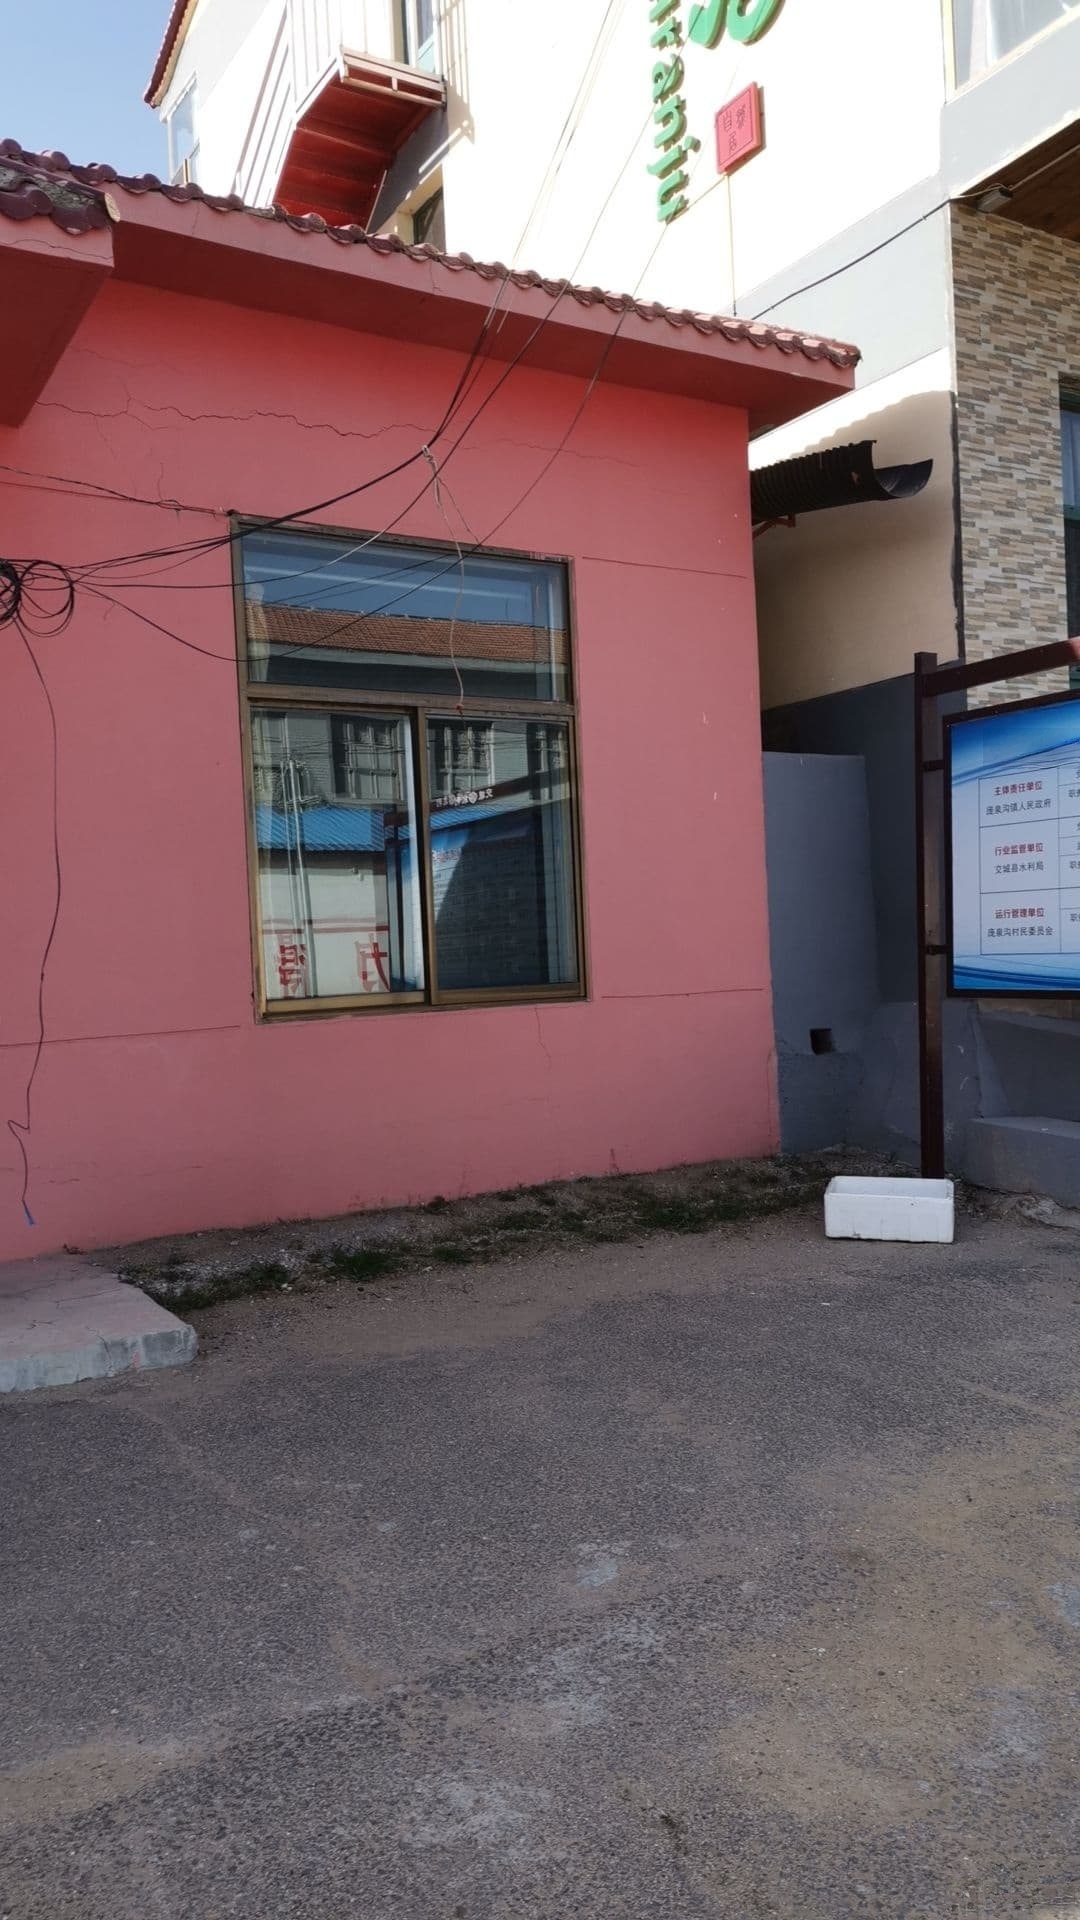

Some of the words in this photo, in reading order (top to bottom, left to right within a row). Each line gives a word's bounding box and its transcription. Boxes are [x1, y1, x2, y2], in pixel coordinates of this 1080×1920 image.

[993, 780, 1043, 796] 主体责任单位
[994, 861, 1045, 874] 交城县水利局
[994, 907, 1045, 920] 运行管理单位
